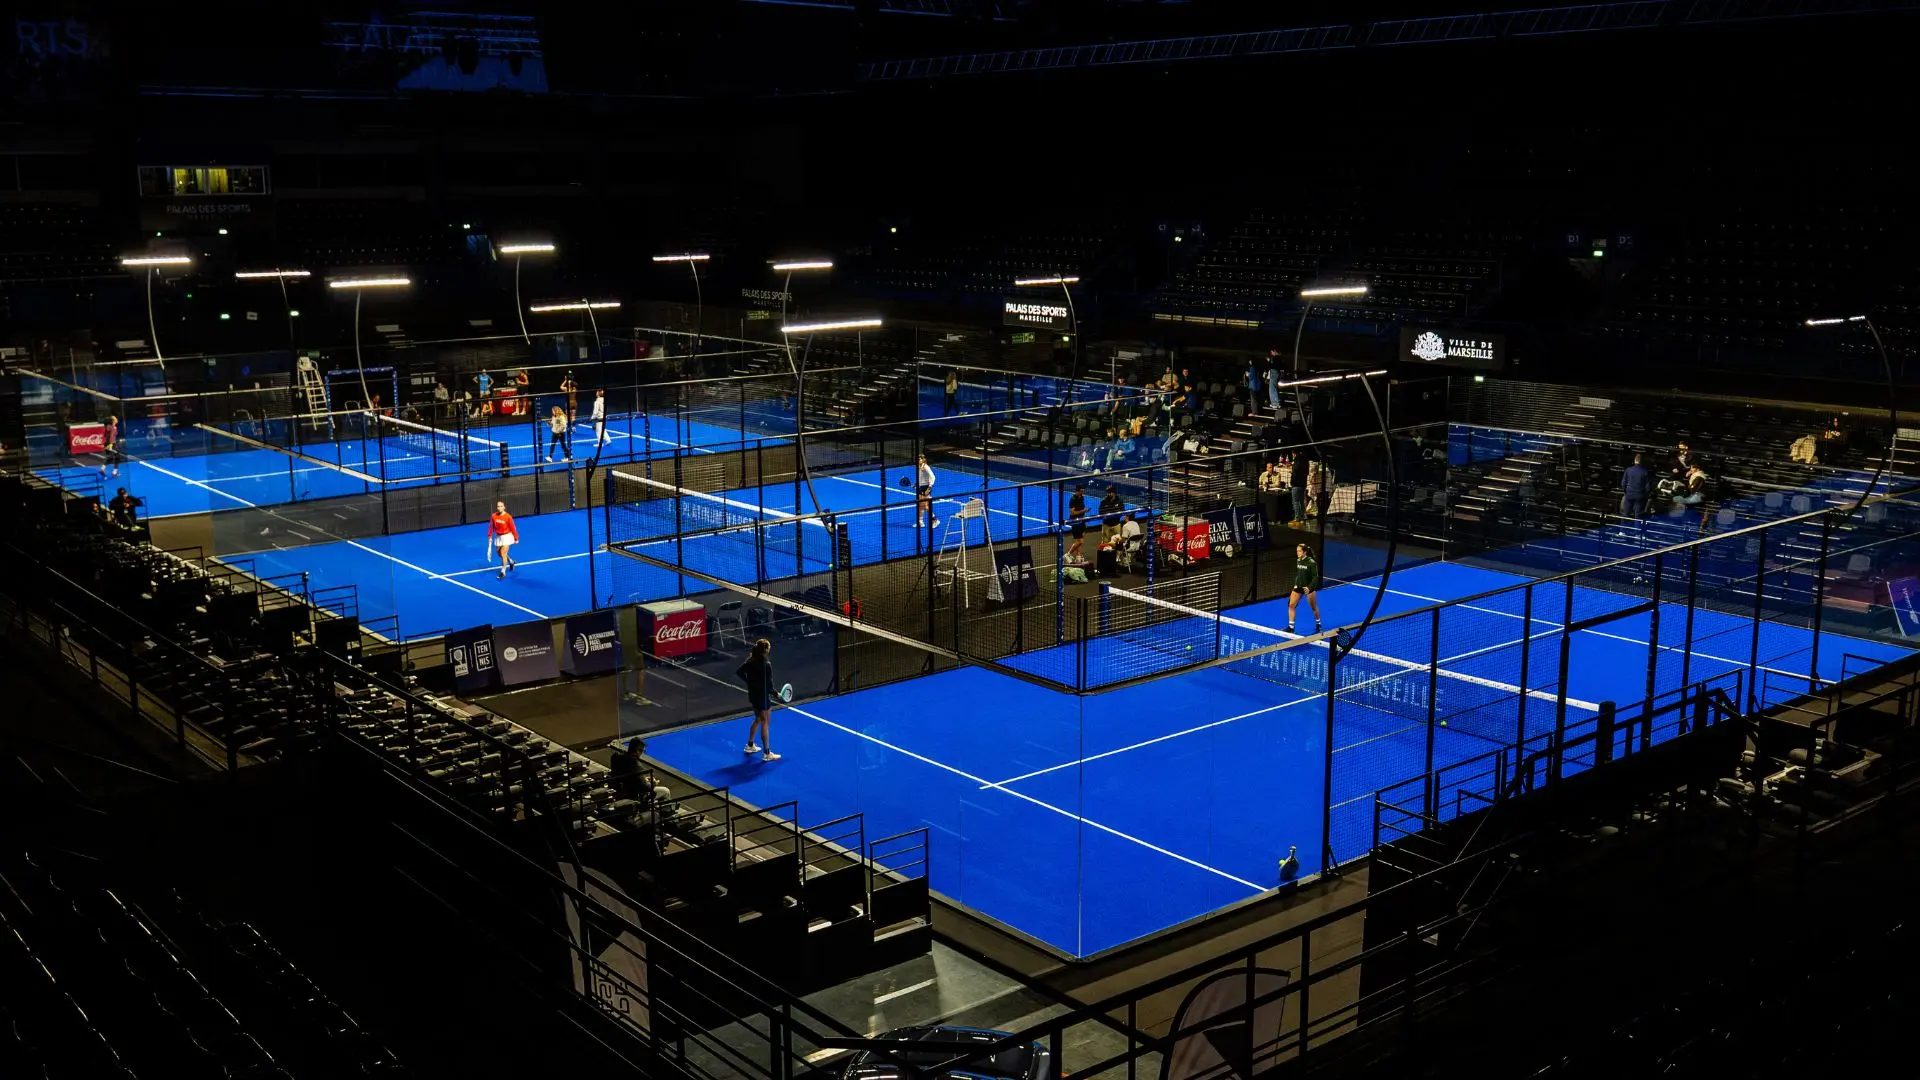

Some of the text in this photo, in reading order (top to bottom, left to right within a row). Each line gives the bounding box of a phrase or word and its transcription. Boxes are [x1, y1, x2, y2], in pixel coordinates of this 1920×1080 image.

[1005, 302, 1067, 318] PALAIS DES SPORTS
[1019, 314, 1053, 324] MARSEILLE
[1449, 338, 1493, 349] VILLE DE
[1448, 346, 1494, 360] MARSEILLE
[656, 619, 703, 643] Coca-Cola
[476, 644, 489, 654] TEN
[478, 656, 491, 666] NIS
